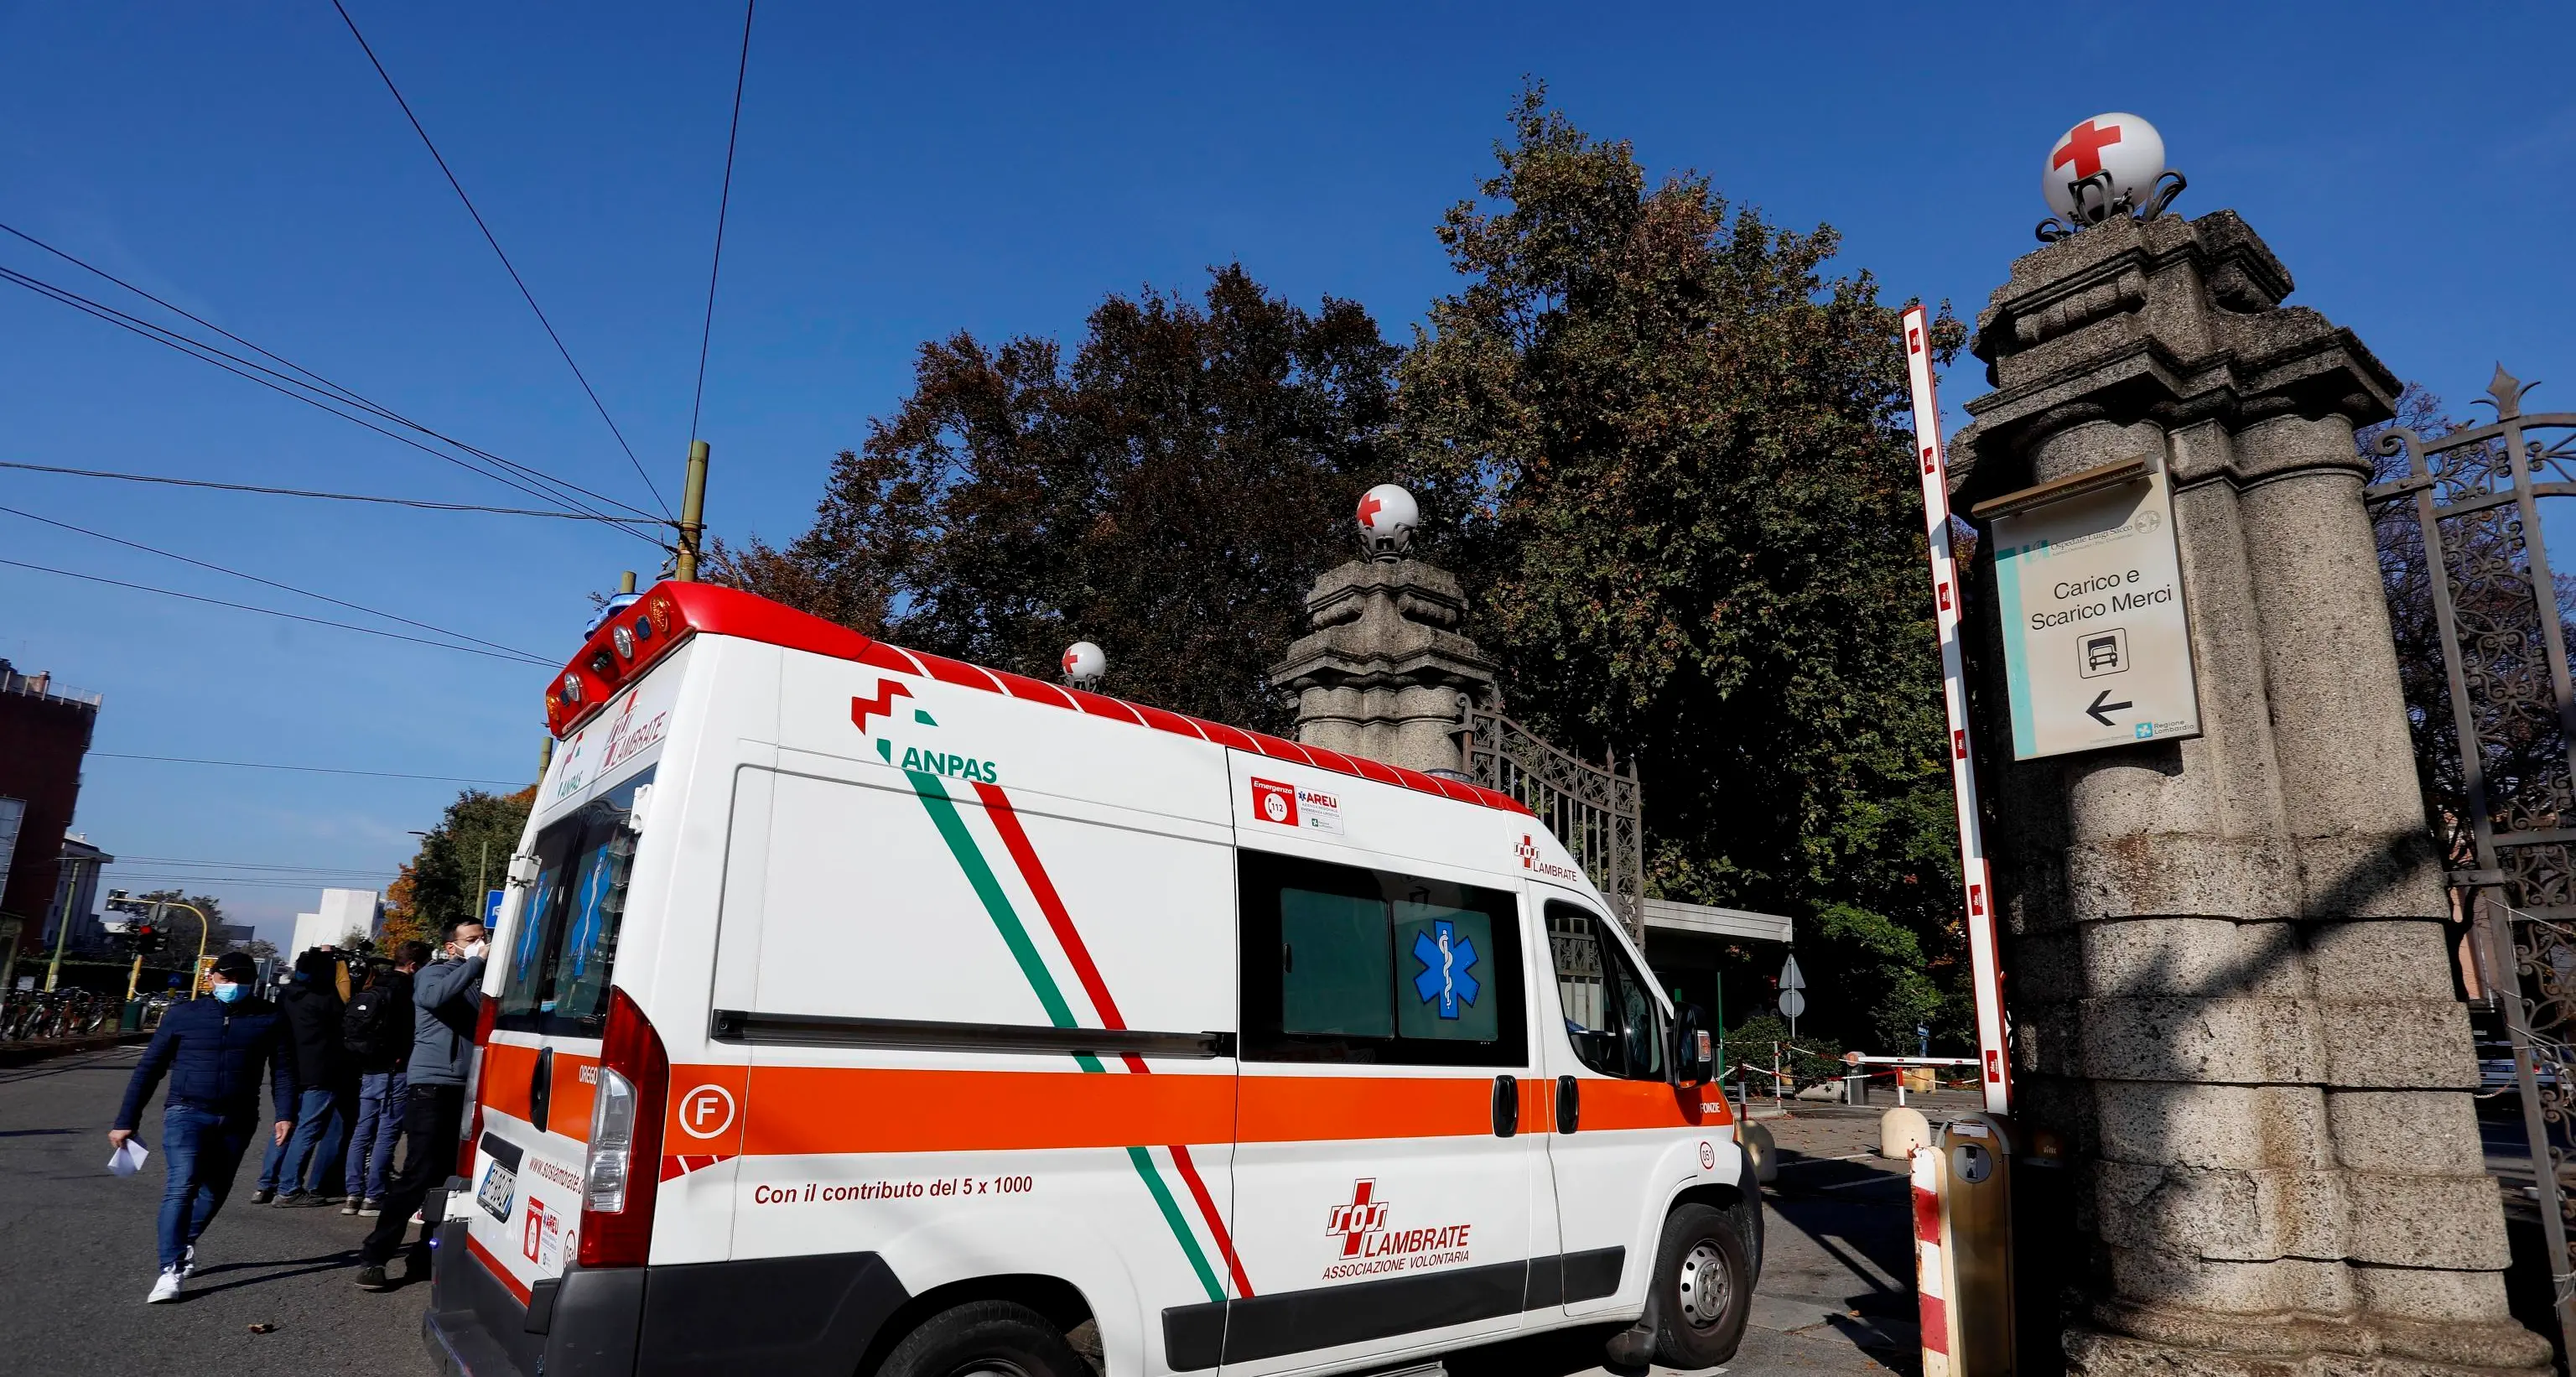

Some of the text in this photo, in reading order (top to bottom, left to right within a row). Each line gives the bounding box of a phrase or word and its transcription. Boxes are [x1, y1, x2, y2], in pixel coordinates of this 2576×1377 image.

[2050, 537, 2087, 551] Ospedale
[2088, 530, 2108, 540] Luigi
[2109, 525, 2133, 535] Sacco
[2054, 569, 2140, 600] Carico e
[2031, 585, 2173, 631] Scarico Merci
[610, 711, 667, 766] LAMBRATE
[2153, 720, 2184, 729] Regione
[2154, 725, 2194, 735] Lombardia
[901, 746, 997, 783] ANPAS
[1254, 781, 1292, 794] Emergenza
[1306, 792, 1337, 808] AREU
[1271, 803, 1284, 813] 112
[1514, 842, 1540, 860] SOS
[1533, 860, 1577, 881] LAMBRATE
[695, 1097, 719, 1125] F
[1701, 1150, 1713, 1161] 051
[528, 1157, 584, 1195] www.soslambrate.o
[755, 1176, 1033, 1204] Con il contributo del 5 x 1000
[1327, 1203, 1389, 1236] SOS
[1364, 1224, 1471, 1258] LAMBRATE
[1322, 1250, 1469, 1280] ASSOCIAZIONE VOLONTARIA
